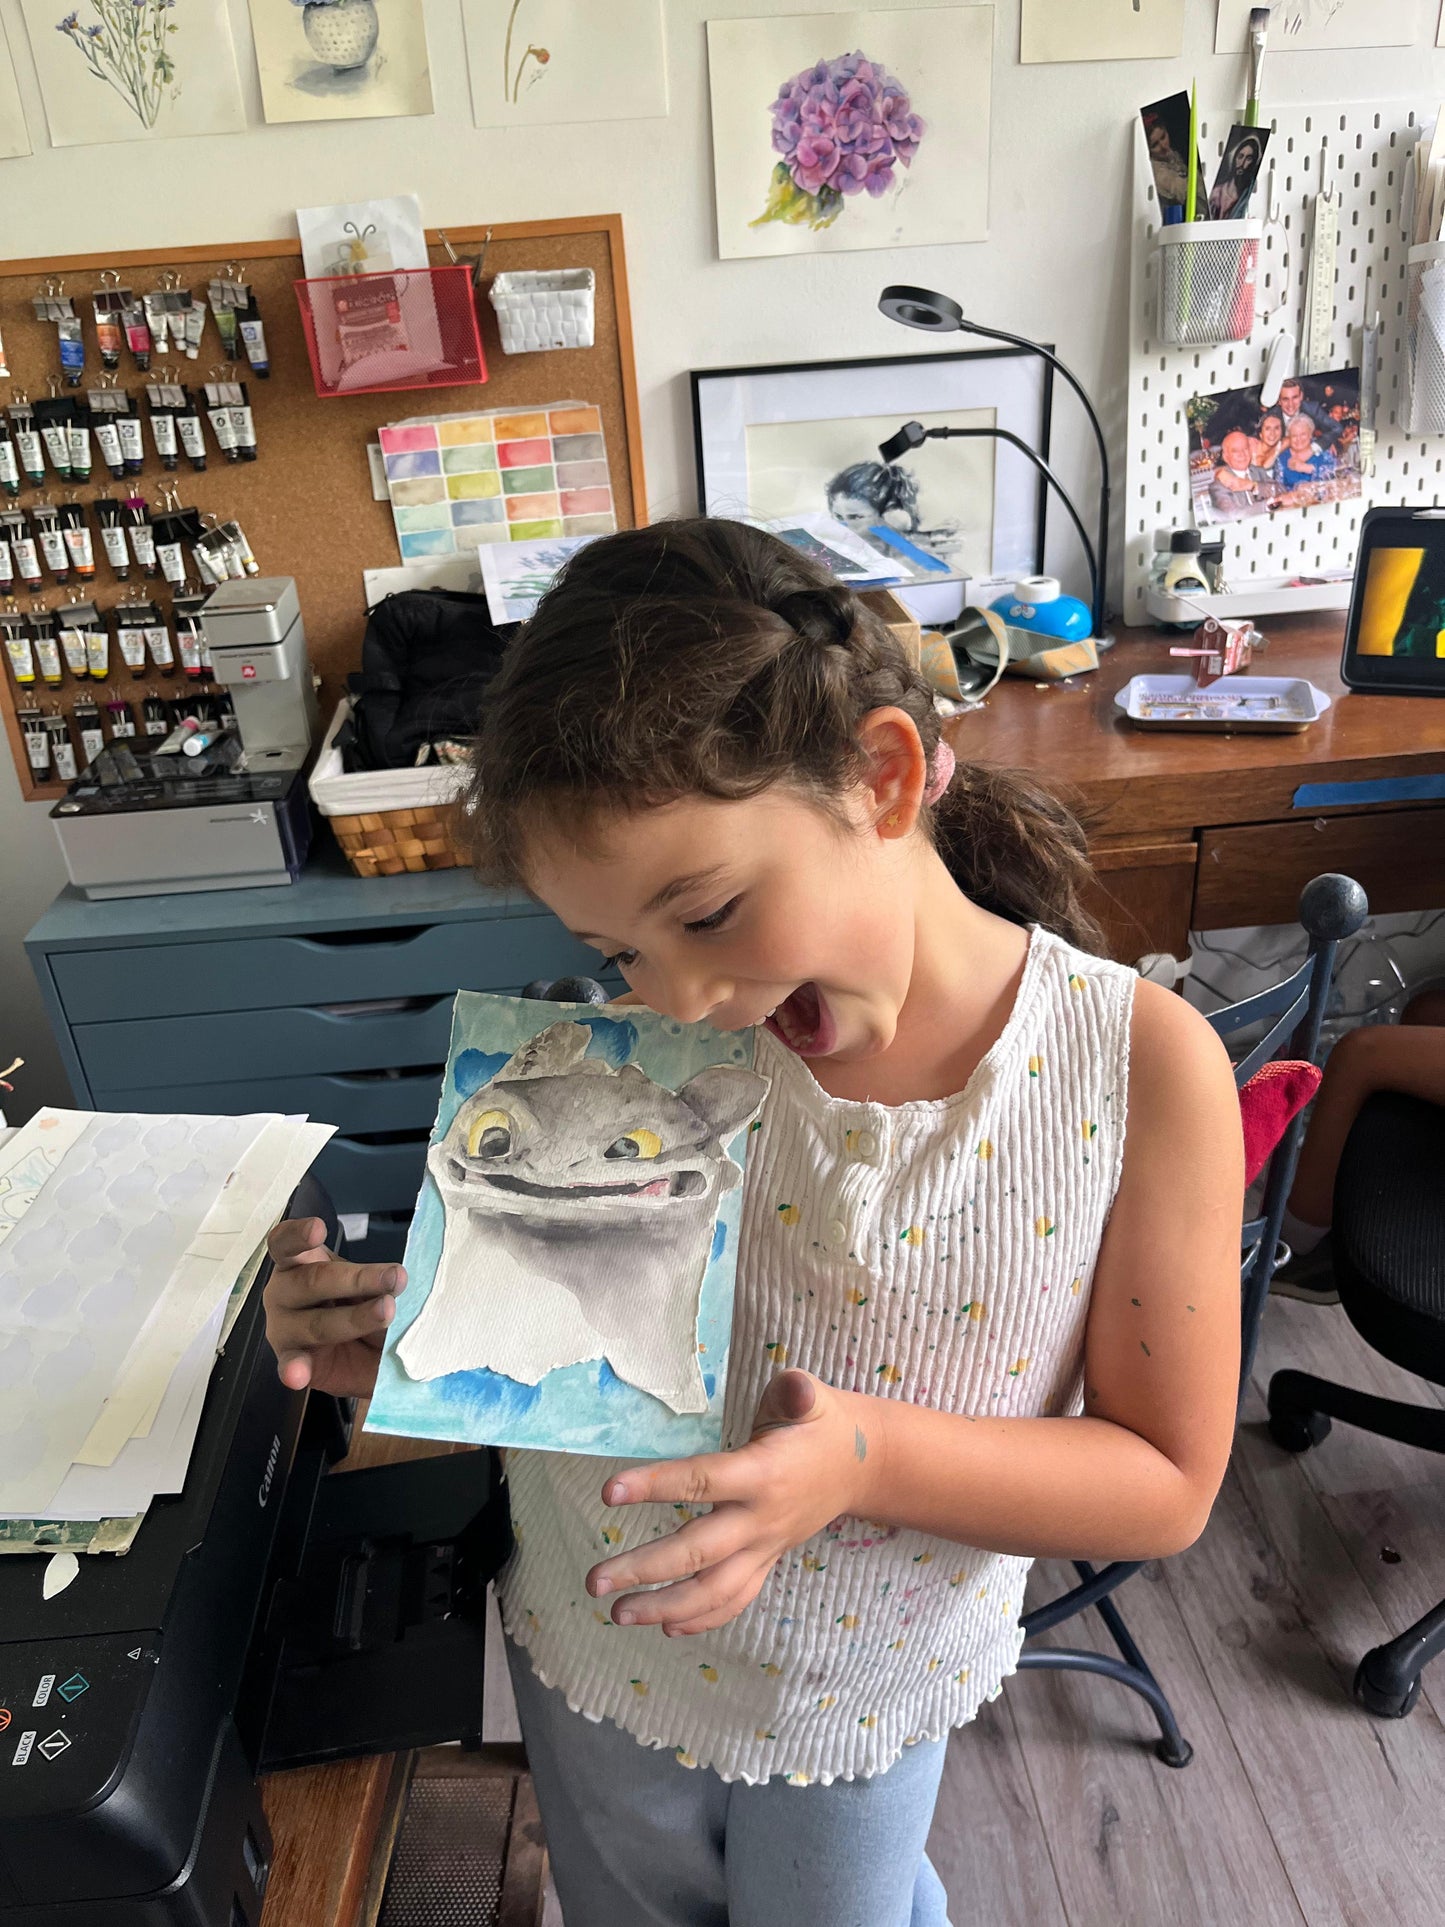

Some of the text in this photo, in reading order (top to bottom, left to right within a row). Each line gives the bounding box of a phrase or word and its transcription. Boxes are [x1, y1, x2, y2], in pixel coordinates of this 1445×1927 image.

[258, 1433, 281, 1508] Canon
[35, 1676, 53, 1705] COLOR
[15, 1733, 34, 1763] BLACK
